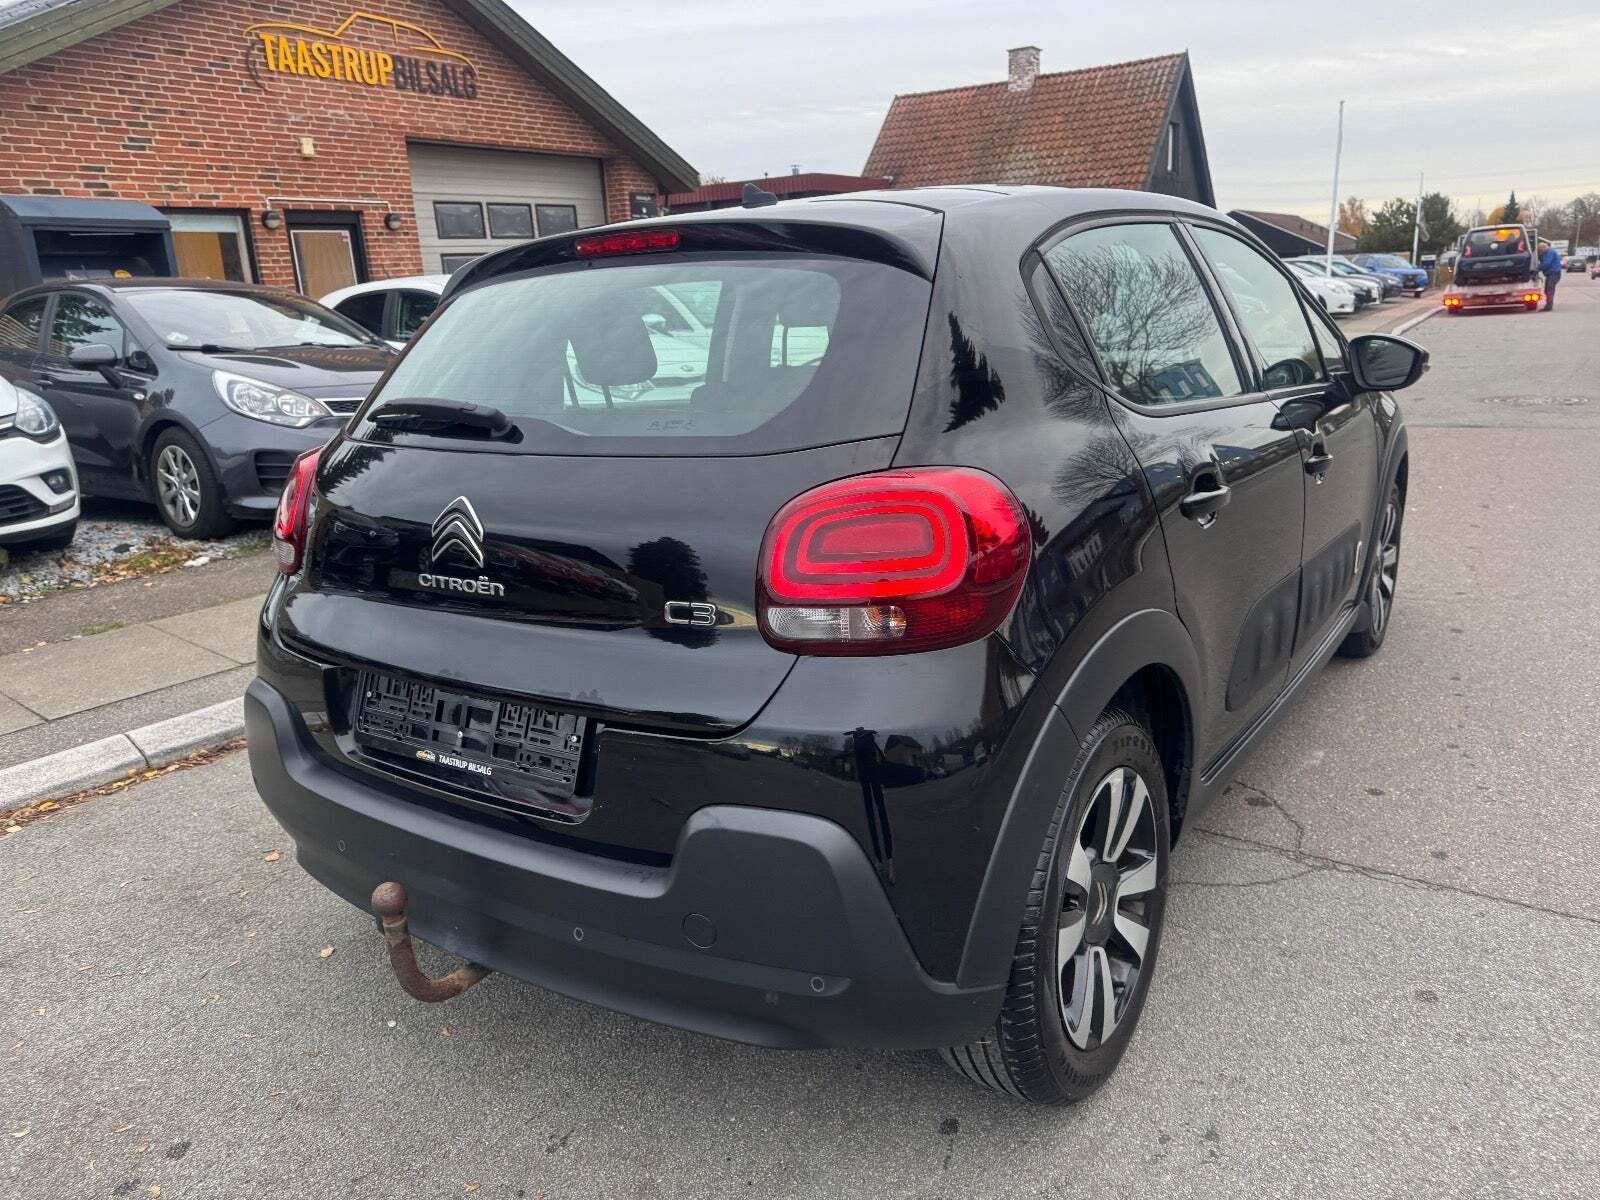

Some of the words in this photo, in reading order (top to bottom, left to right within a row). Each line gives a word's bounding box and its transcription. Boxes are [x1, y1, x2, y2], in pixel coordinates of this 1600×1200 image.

[664, 601, 716, 626] C3
[438, 754, 467, 768] TAASTRUP
[468, 762, 492, 775] BILSALG
